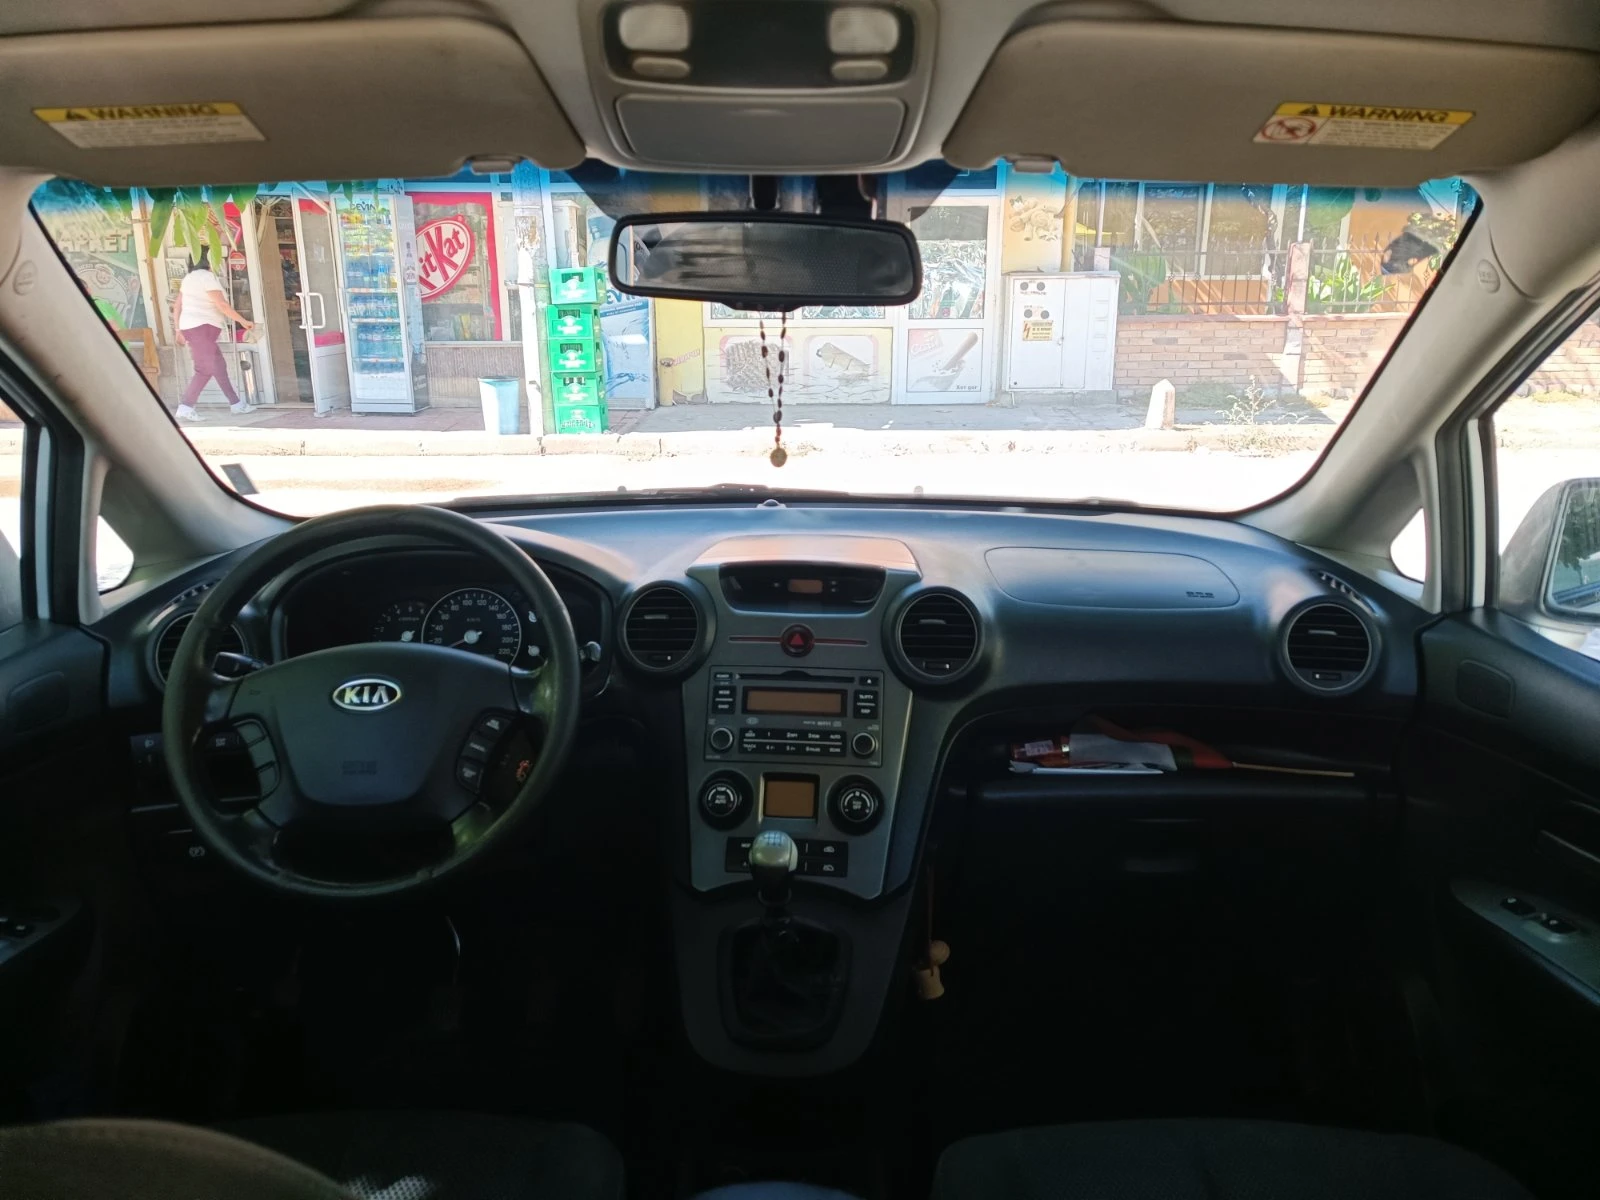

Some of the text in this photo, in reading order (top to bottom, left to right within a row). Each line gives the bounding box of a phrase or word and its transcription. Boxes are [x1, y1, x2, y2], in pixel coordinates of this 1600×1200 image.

[90, 104, 219, 120] WARNING
[1330, 106, 1449, 123] WARNING
[56, 228, 133, 253] АРКЕТ
[344, 685, 389, 704] KIA
